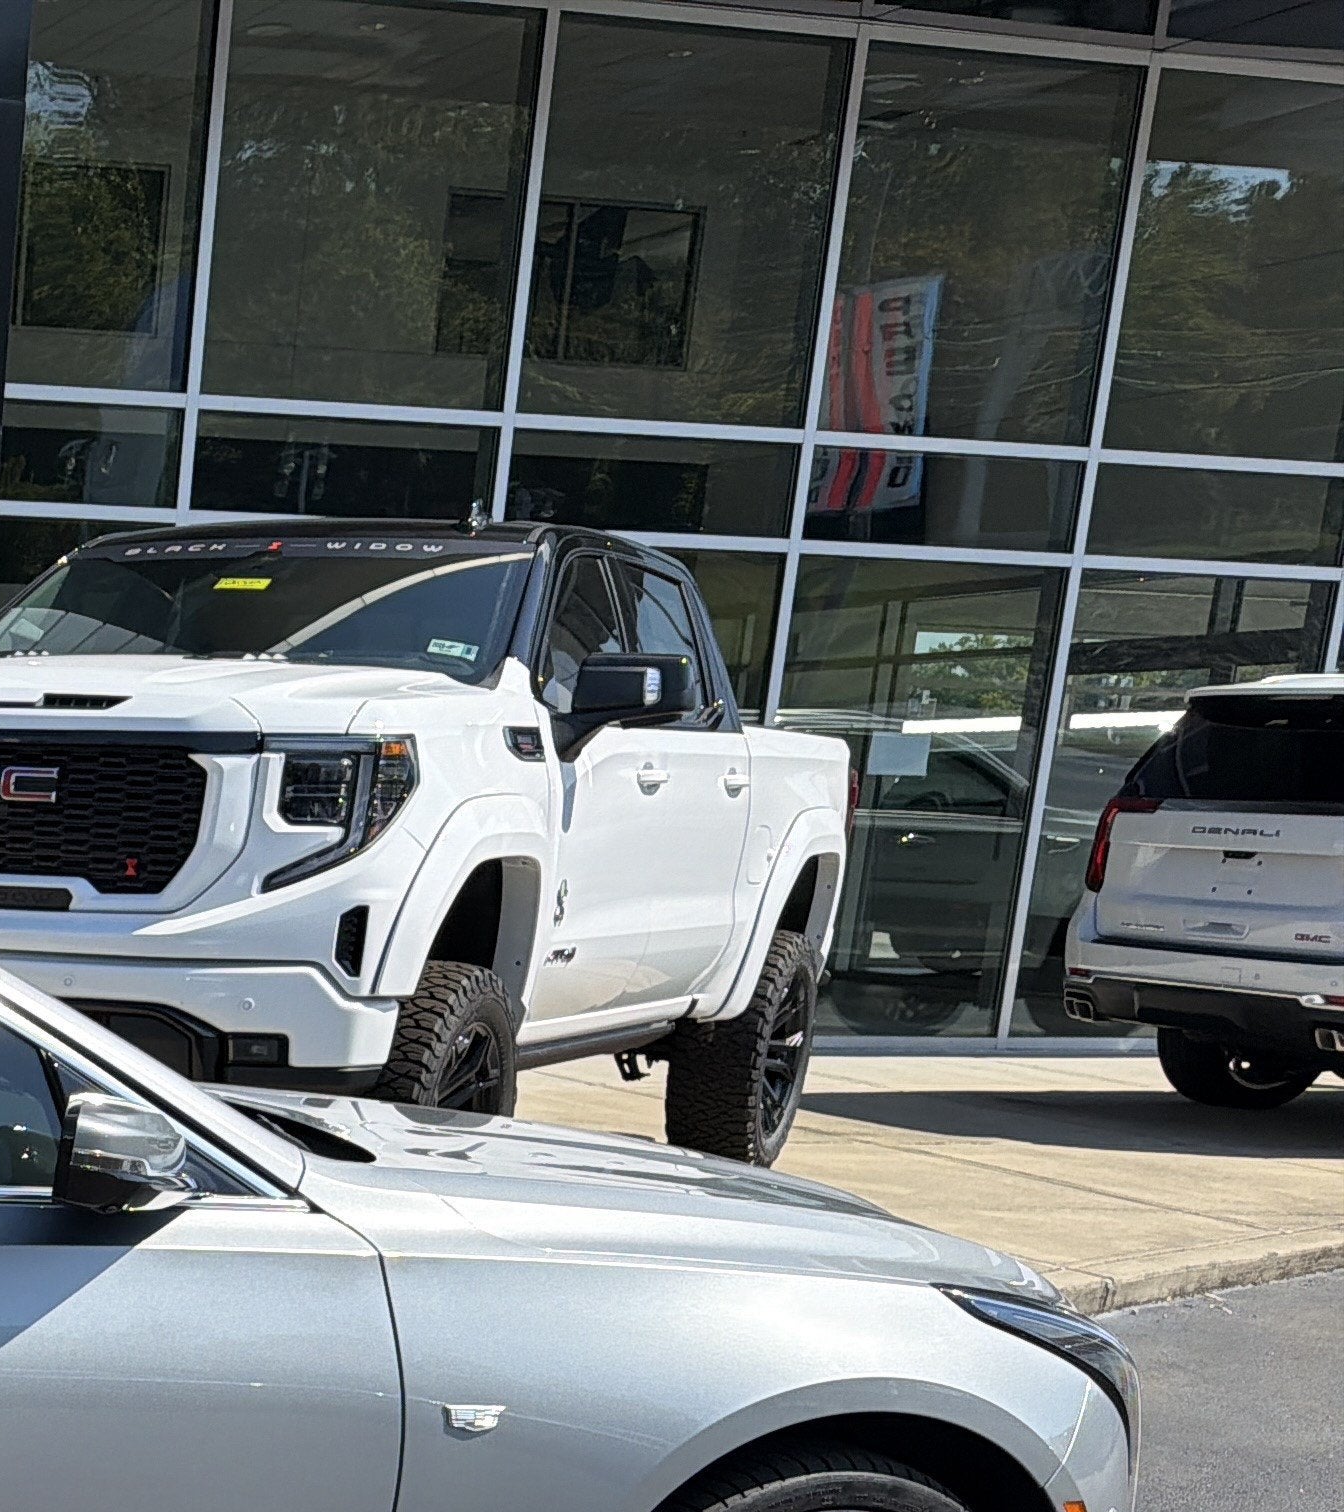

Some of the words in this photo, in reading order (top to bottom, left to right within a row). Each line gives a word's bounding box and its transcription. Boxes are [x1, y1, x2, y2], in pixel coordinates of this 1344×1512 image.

[124, 543, 227, 556] BLACK
[326, 541, 444, 553] WIDOW
[1191, 825, 1281, 838] DENALI
[1294, 932, 1332, 944] GMC
